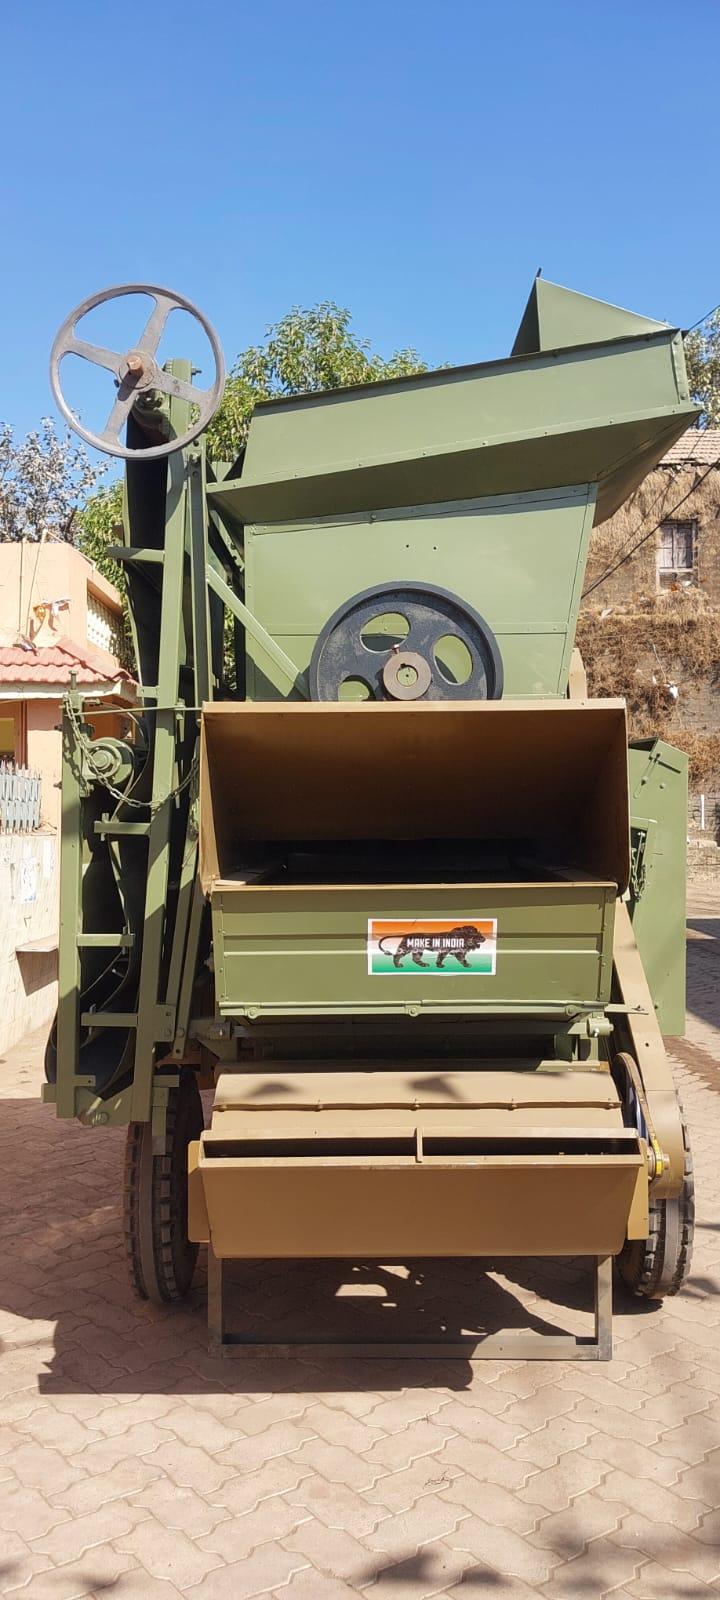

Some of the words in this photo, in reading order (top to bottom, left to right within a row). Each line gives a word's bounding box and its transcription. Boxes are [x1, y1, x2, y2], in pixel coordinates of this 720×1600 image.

[406, 938, 430, 948] MAKE
[432, 938, 441, 948] IN
[442, 938, 465, 948] INDIA
